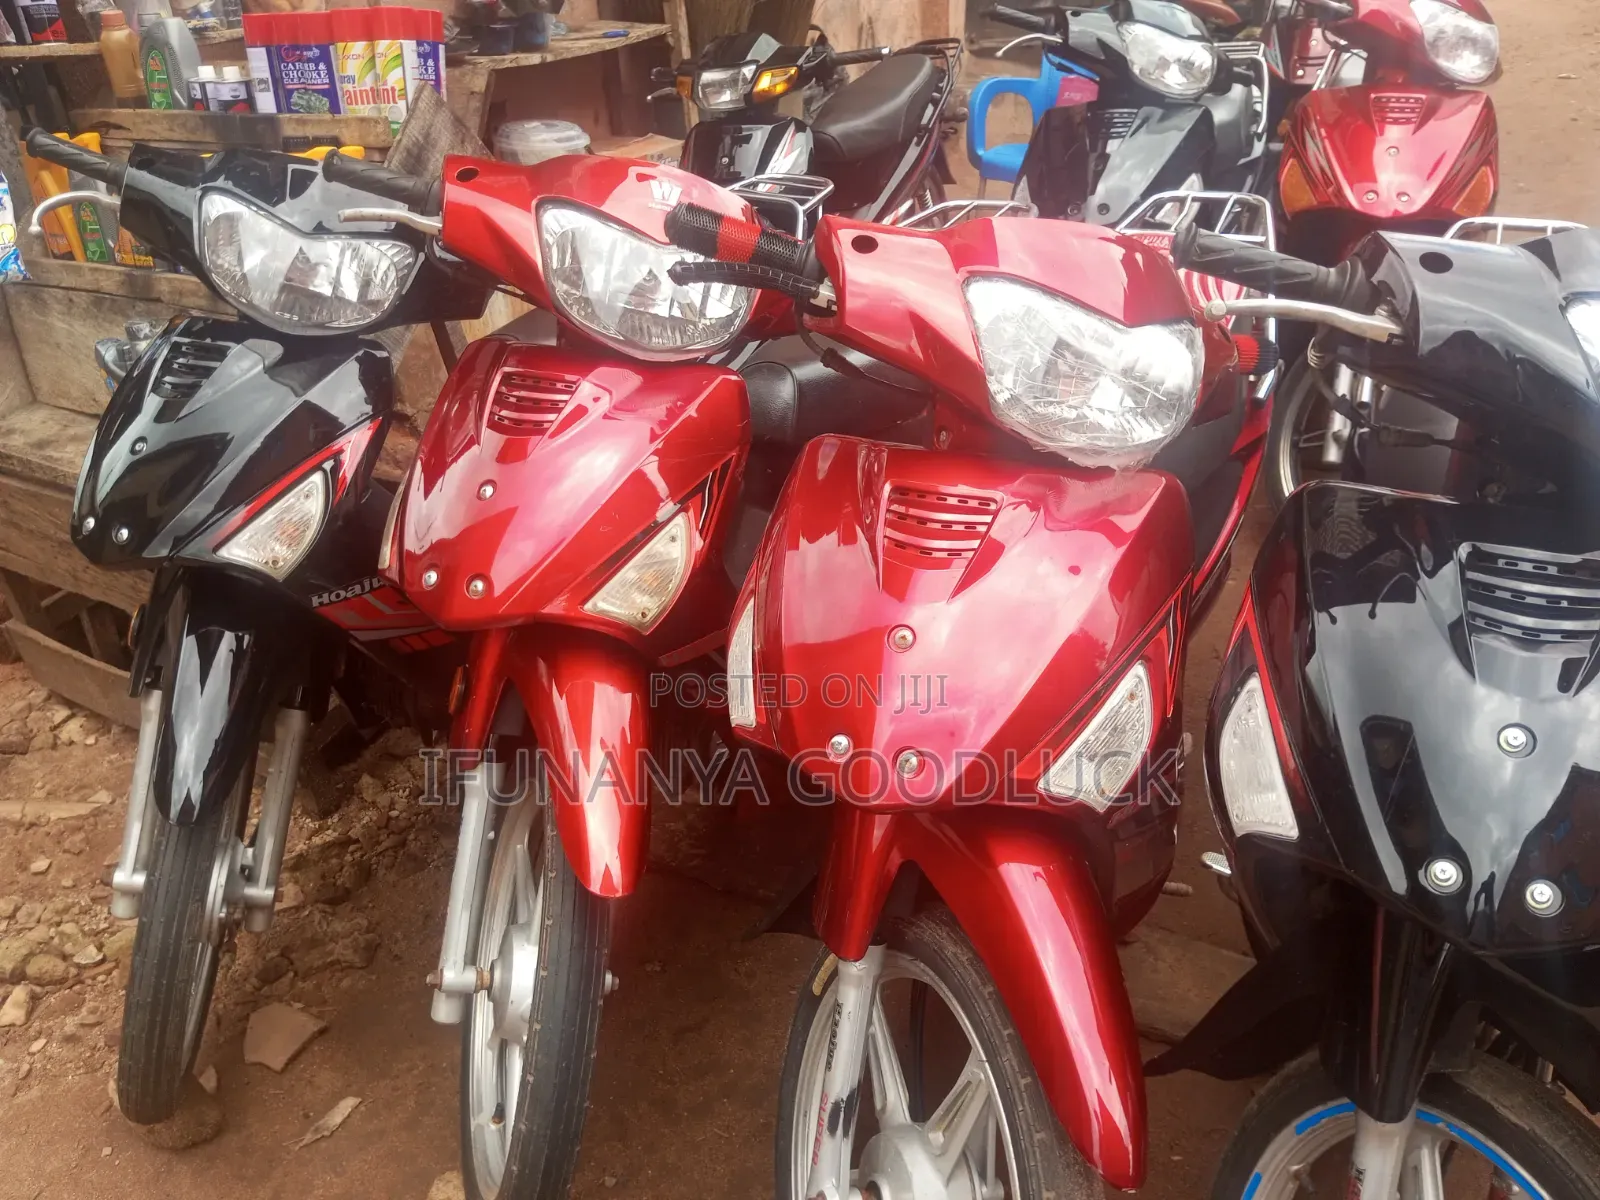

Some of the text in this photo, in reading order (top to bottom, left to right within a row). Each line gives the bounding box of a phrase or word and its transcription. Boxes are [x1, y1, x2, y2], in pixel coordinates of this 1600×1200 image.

[342, 85, 376, 106] aint
[311, 576, 389, 608] Hoaju
[812, 1092, 829, 1167] SUPER
